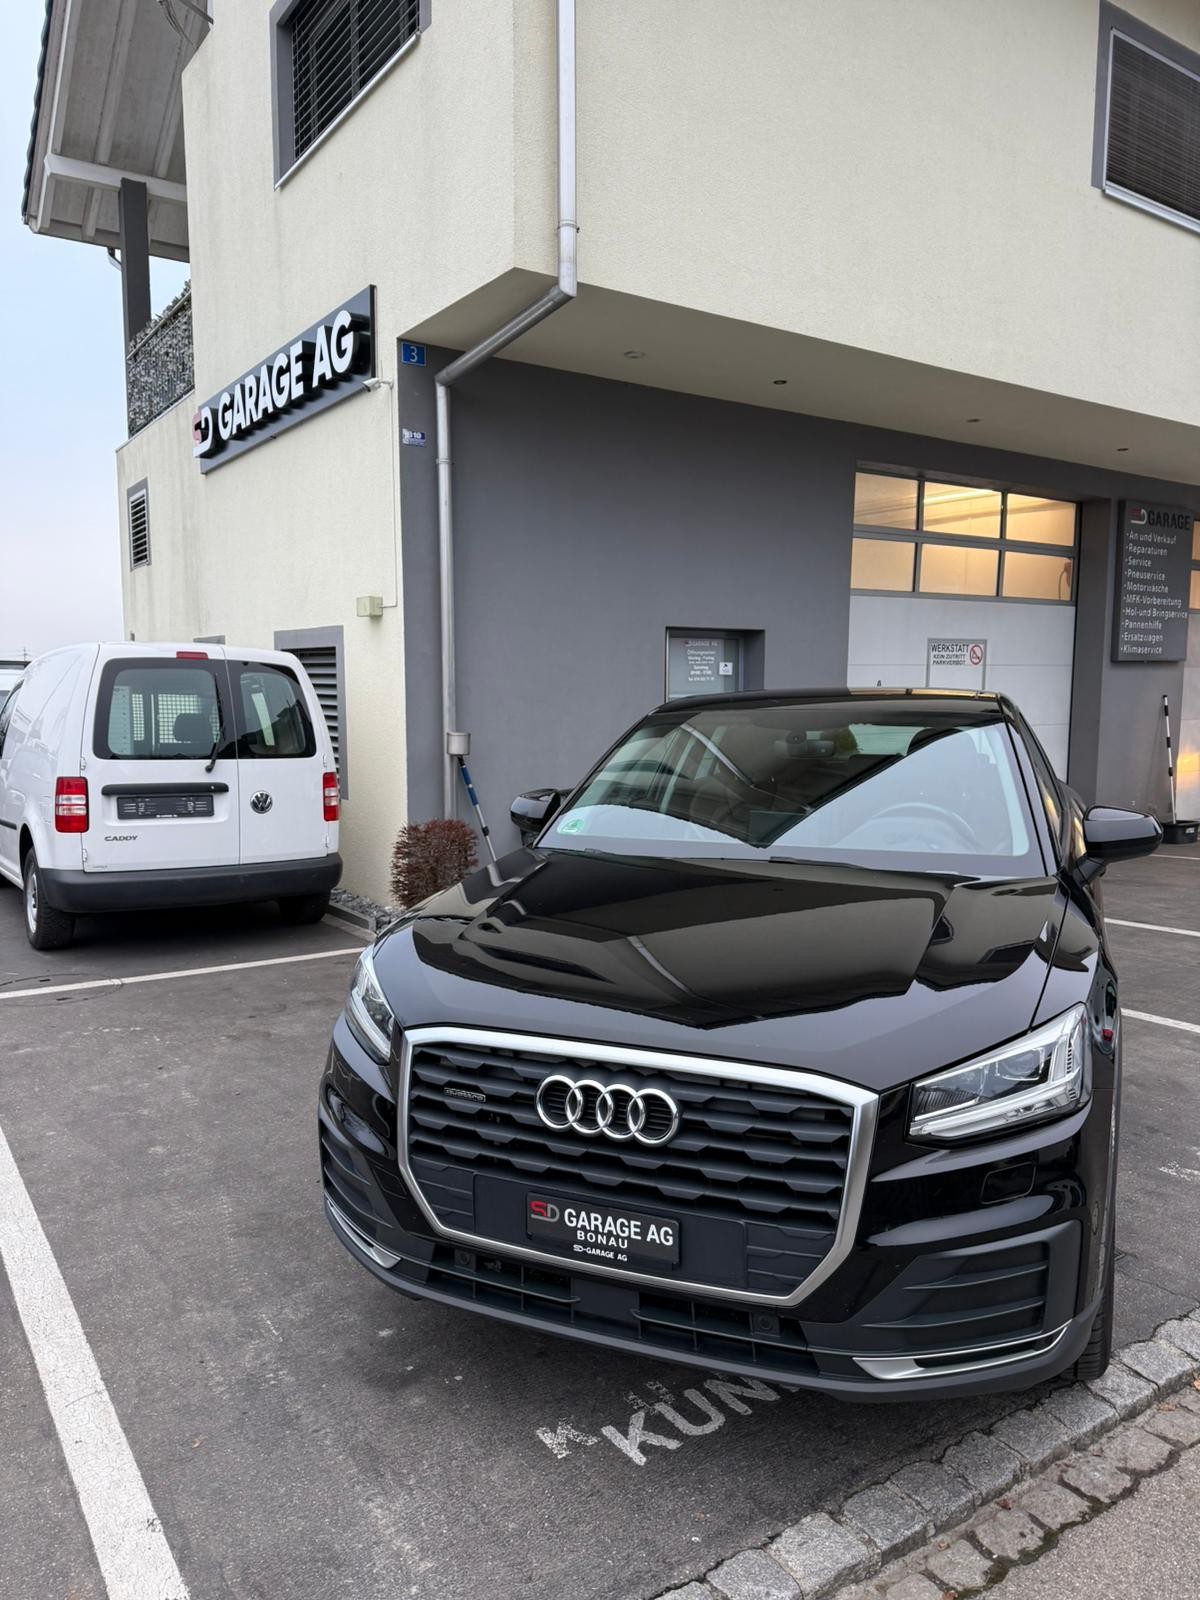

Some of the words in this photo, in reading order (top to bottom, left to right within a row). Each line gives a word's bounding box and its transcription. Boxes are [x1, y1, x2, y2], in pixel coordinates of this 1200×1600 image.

[409, 345, 418, 362] 3
[218, 340, 304, 440] GARAGE
[312, 310, 354, 388] AG
[1148, 510, 1191, 531] GARAGE
[1129, 530, 1138, 540] An
[1140, 533, 1152, 542] und
[1153, 533, 1177, 545] Verkauf
[1128, 543, 1168, 556] Reparaturen
[1127, 556, 1152, 567] Service
[1127, 569, 1166, 581] Pneuservice
[1125, 594, 1182, 609] MFK-Vorbereitung
[1152, 608, 1188, 620] Bringservice
[1124, 619, 1163, 630] Pannenhilfe
[1123, 632, 1164, 644] Ersatzwagen
[931, 643, 969, 653] WERKSTATT
[1122, 644, 1163, 655] Klimaservice
[530, 1200, 560, 1223] SD
[564, 1208, 642, 1240] GARAGE
[646, 1224, 674, 1246] AG
[576, 1230, 628, 1249] BONAU
[616, 1253, 628, 1262] AG
[600, 1371, 799, 1467] KUN
